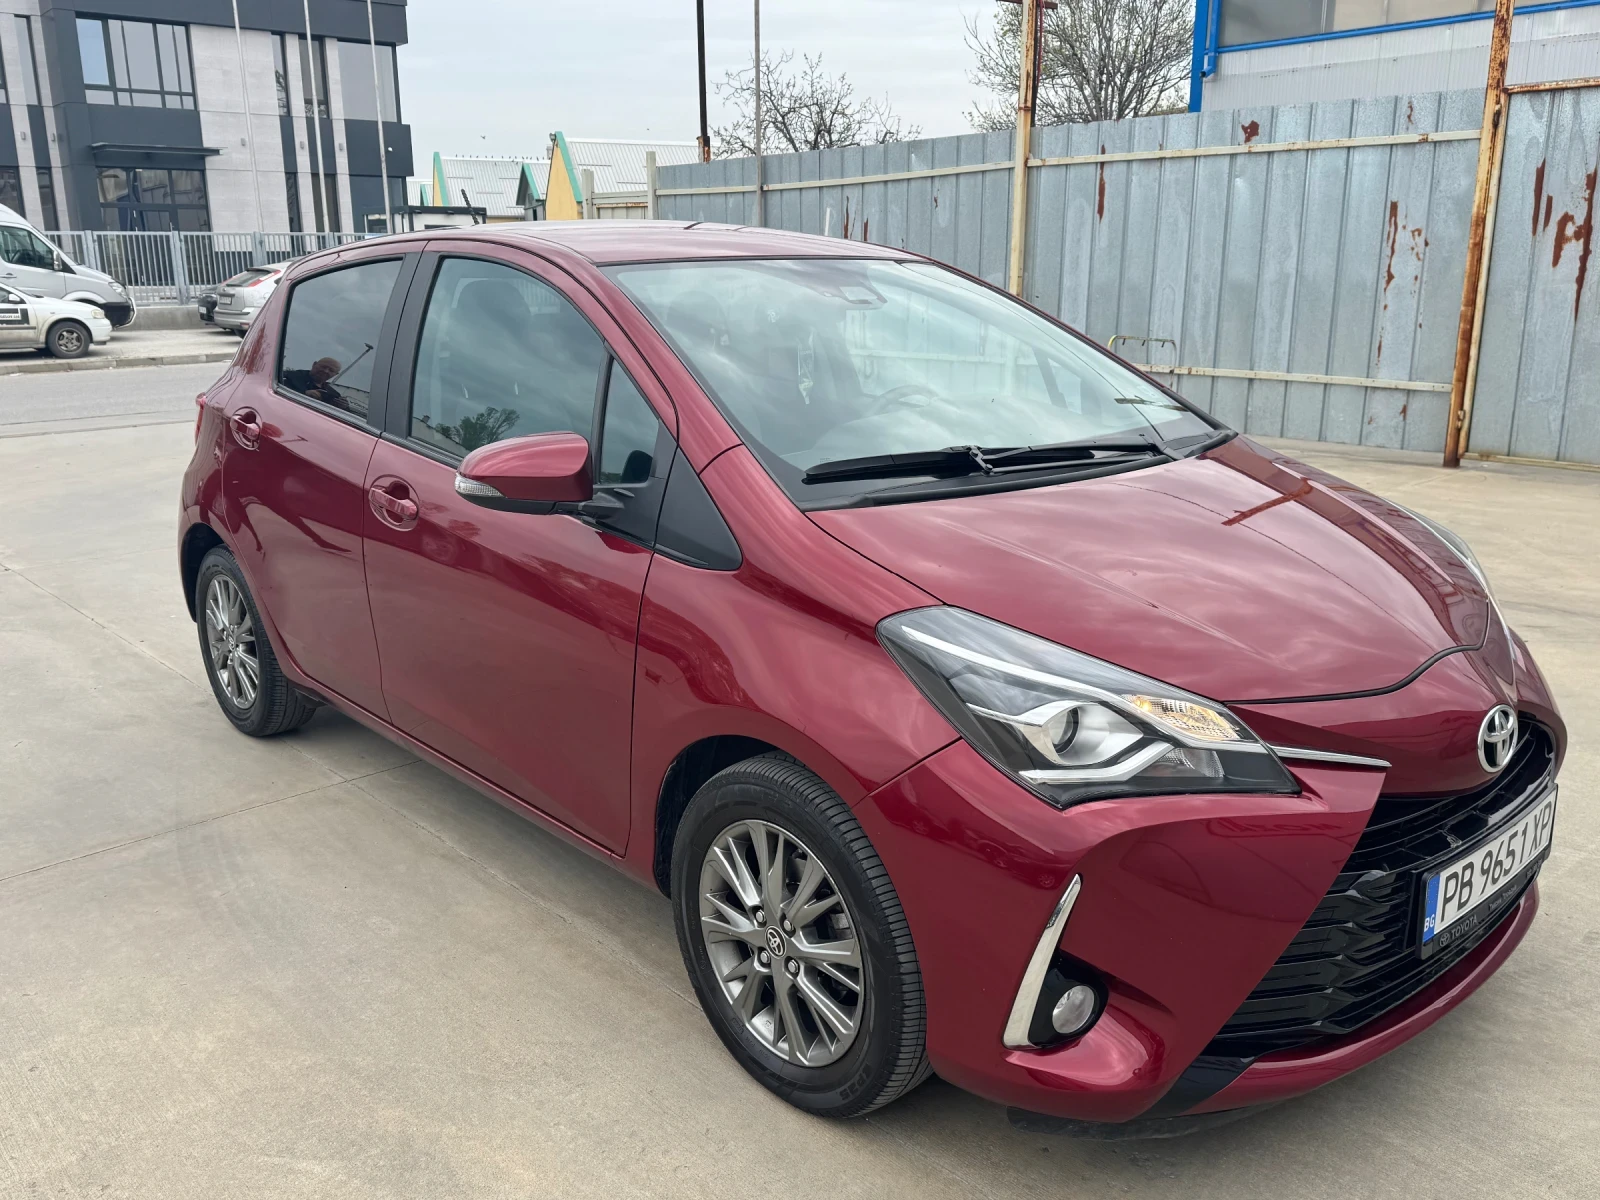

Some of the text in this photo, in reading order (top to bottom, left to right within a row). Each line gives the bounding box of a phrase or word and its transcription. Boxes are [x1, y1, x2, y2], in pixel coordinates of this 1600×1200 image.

[1441, 861, 1475, 923] PB
[1480, 821, 1528, 896] 9651
[1528, 800, 1552, 857] XP
[1424, 914, 1435, 932] BG
[1451, 915, 1479, 940] TOYOTA
